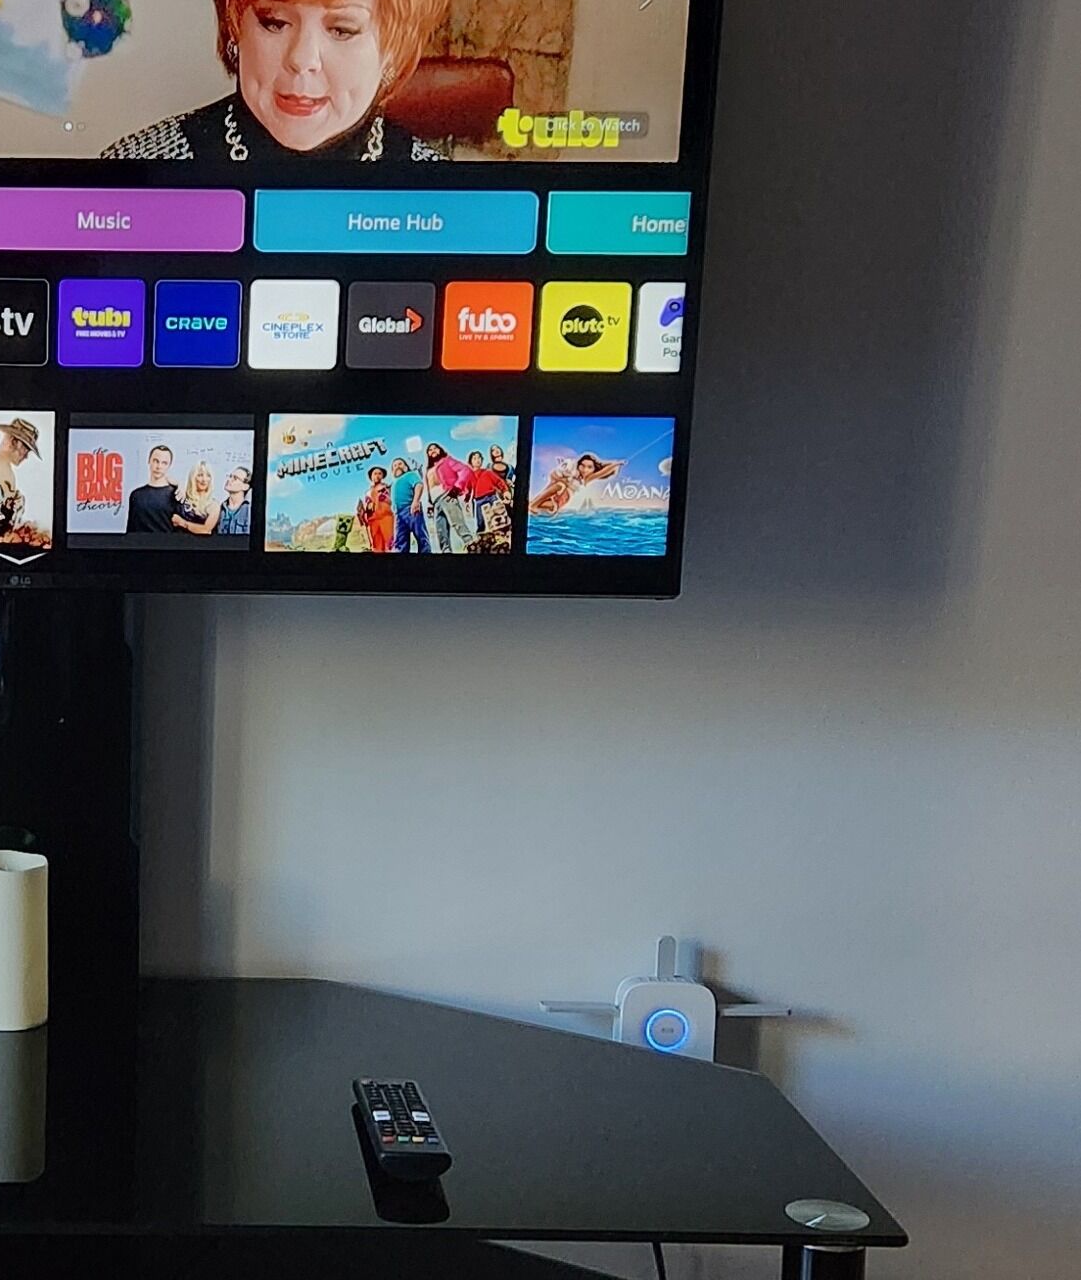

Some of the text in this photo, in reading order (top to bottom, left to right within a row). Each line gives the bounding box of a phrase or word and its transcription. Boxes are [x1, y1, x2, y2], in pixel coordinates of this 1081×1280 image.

[497, 108, 620, 148] tubi
[599, 118, 641, 132] Watch
[77, 211, 131, 229] Music
[348, 213, 444, 231] Home Hub
[632, 215, 686, 233] Home
[1, 307, 35, 336] tv
[71, 306, 131, 328] tubi
[358, 316, 410, 334] Global
[458, 306, 517, 333] fubo
[607, 316, 620, 326] tv
[262, 322, 325, 332] CINEPLEX
[273, 331, 311, 340] STORE
[663, 347, 680, 358] Po
[76, 453, 123, 482] BIG
[277, 439, 387, 478] MINECRAFT
[307, 463, 364, 482] MOVIE
